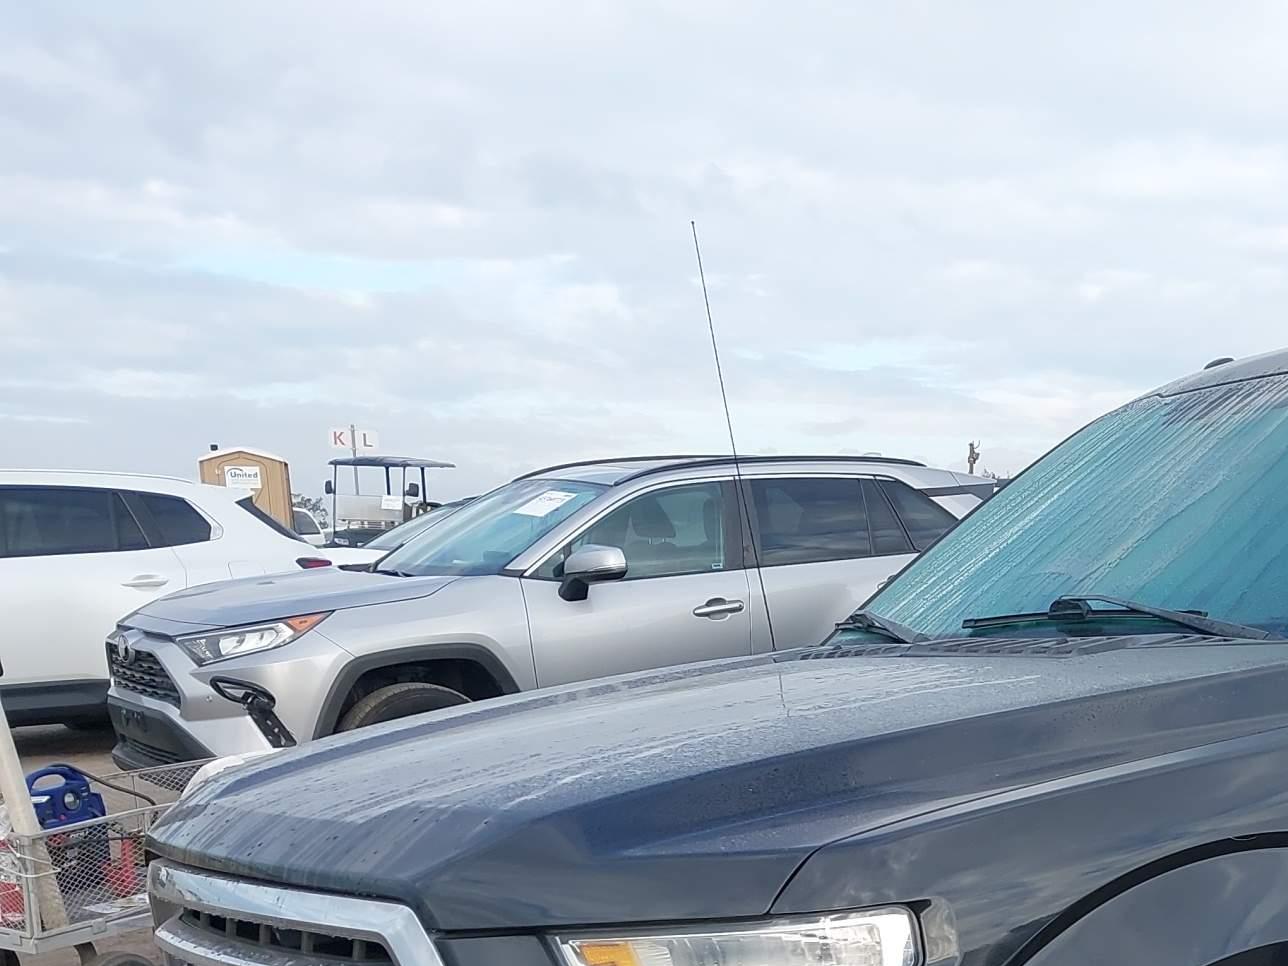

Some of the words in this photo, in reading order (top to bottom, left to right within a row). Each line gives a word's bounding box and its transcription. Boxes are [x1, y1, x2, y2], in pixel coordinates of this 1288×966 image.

[333, 431, 346, 446] K
[362, 432, 374, 448] L
[230, 471, 258, 479] United
